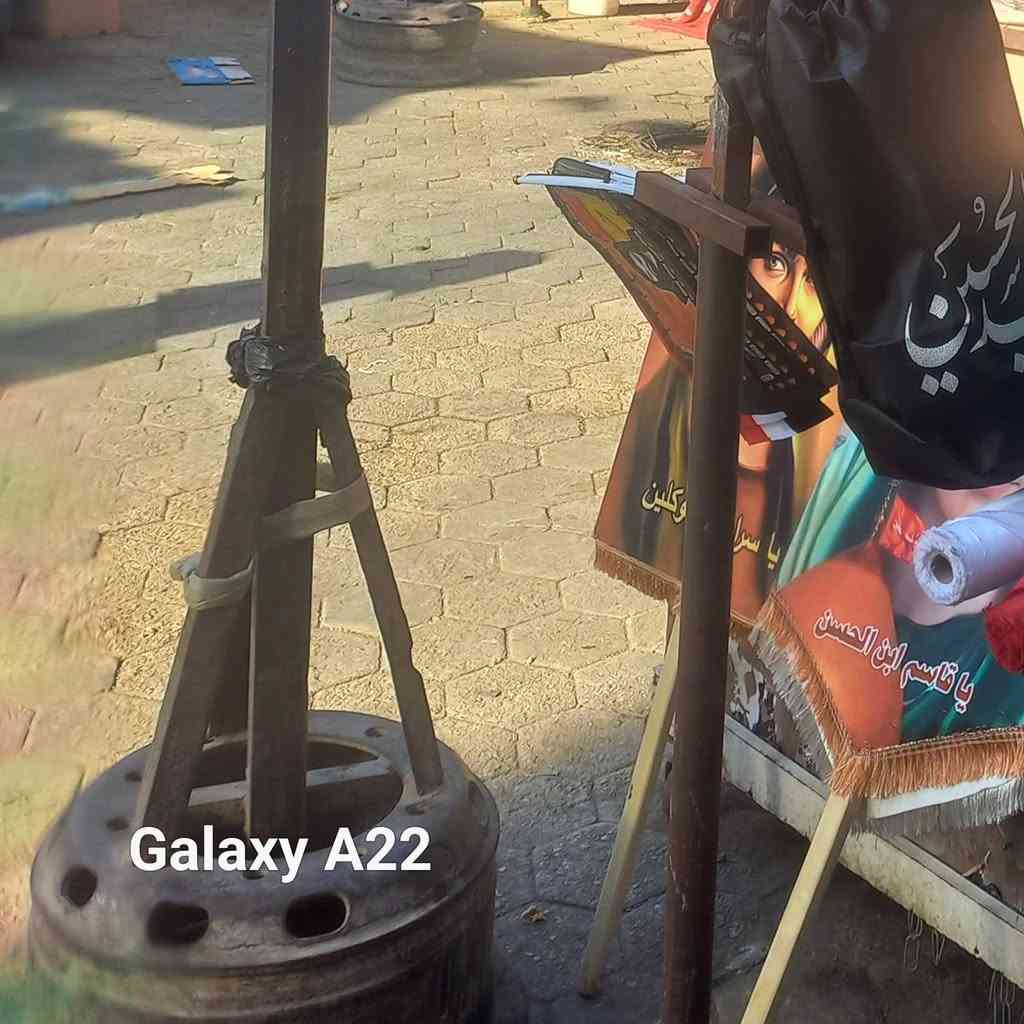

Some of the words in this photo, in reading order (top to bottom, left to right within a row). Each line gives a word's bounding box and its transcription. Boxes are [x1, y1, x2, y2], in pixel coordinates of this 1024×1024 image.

[871, 639, 907, 676] ابن
[900, 660, 959, 695] قاسم
[954, 671, 975, 714] يا
